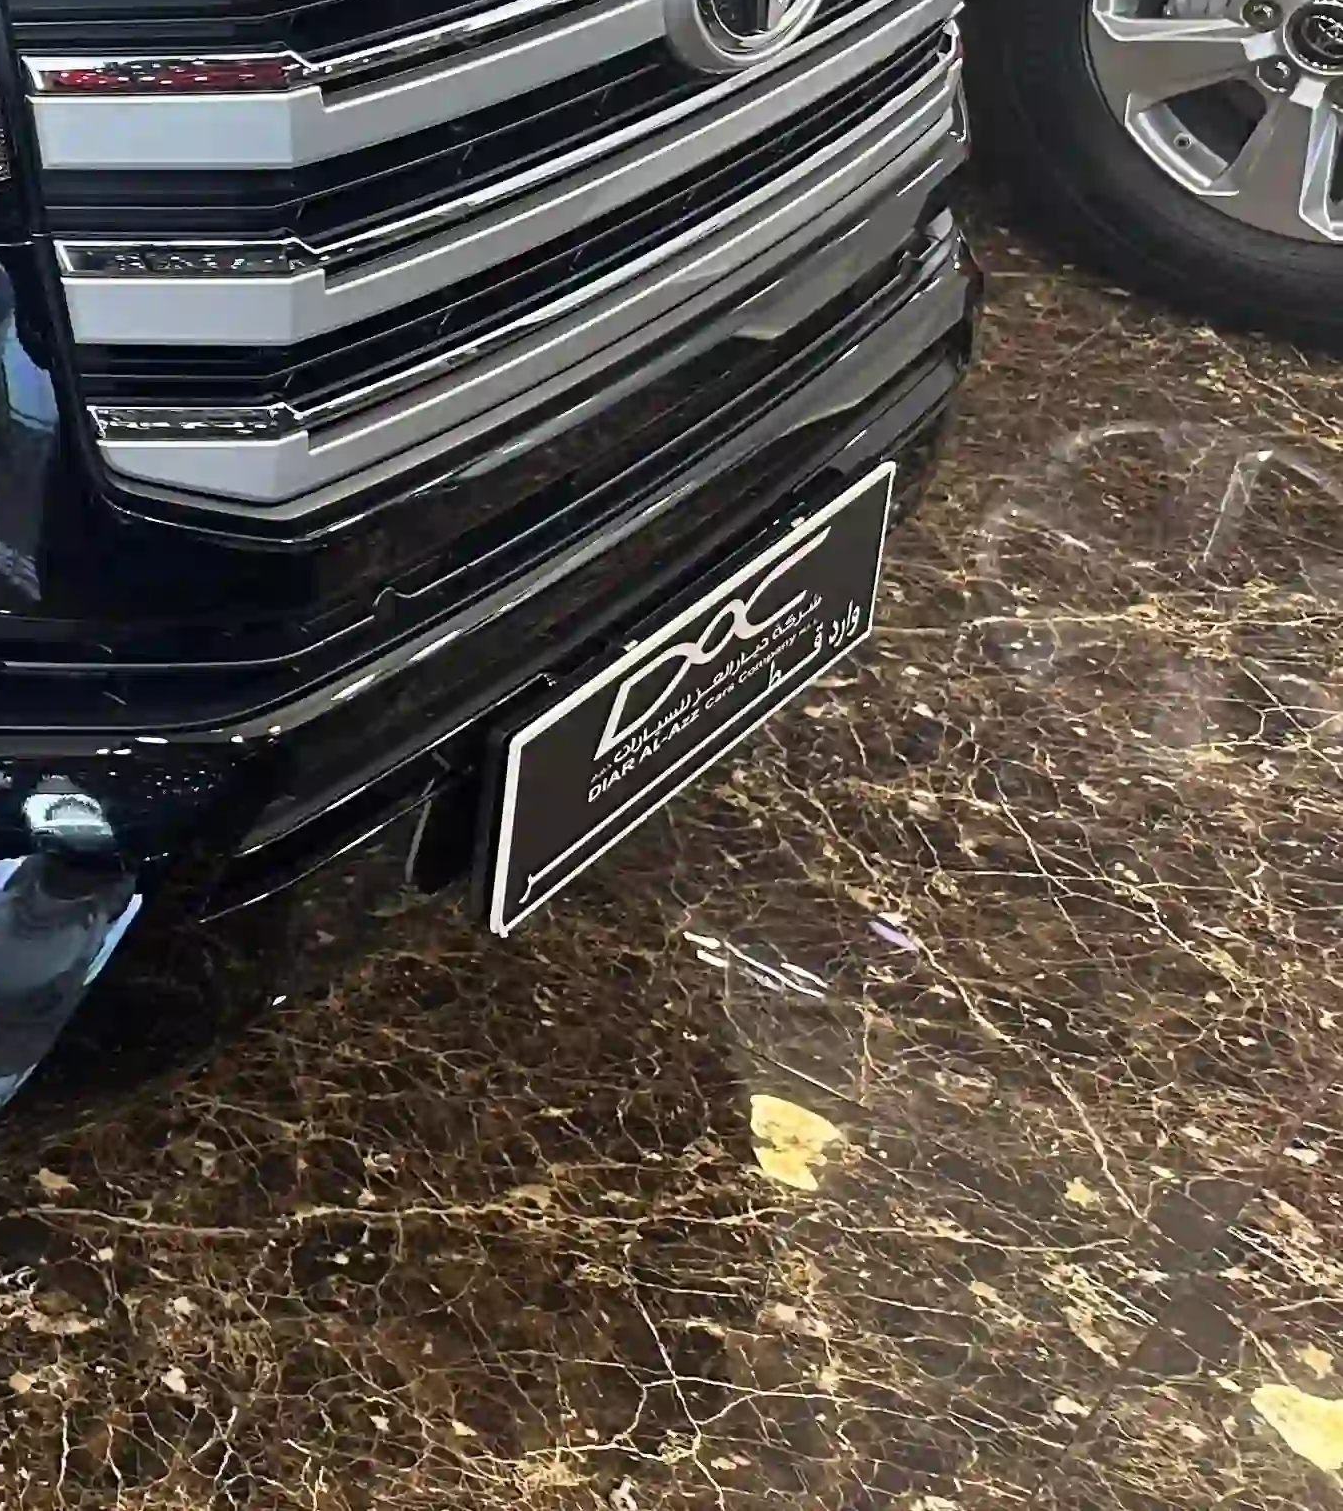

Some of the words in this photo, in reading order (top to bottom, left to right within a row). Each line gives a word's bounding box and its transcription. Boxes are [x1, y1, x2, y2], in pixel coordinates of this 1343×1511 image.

[771, 593, 823, 640] شركة
[828, 598, 860, 648] وارد
[614, 693, 692, 763] للسيارات
[587, 757, 636, 803] DIAR
